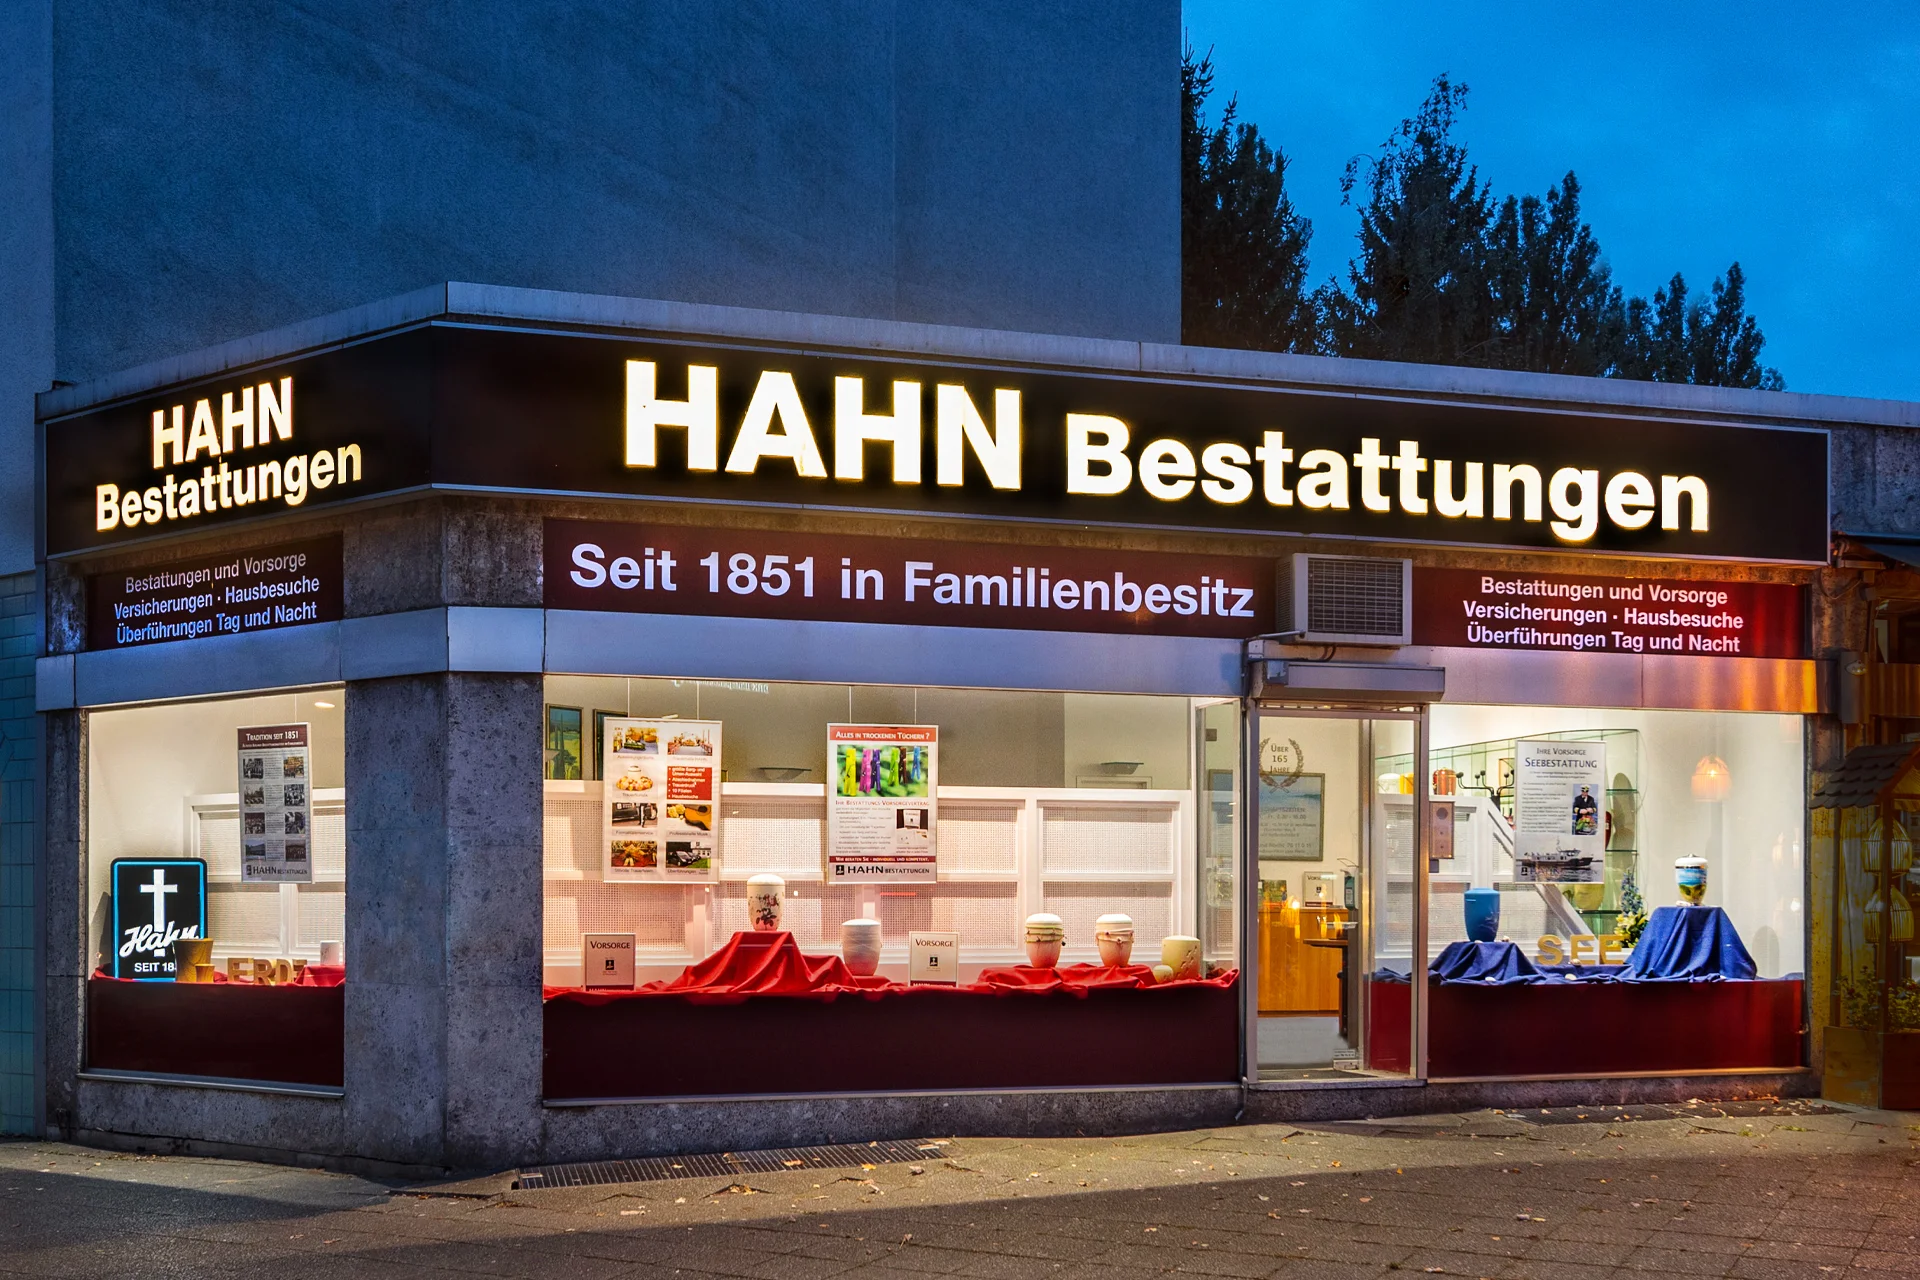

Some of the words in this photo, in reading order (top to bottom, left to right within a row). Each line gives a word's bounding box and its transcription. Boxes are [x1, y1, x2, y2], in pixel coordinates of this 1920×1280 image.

[152, 376, 293, 469] HAHN
[625, 359, 1022, 491] HAHN
[1065, 412, 1710, 542] Bestattungen
[96, 443, 362, 532] Bestattungen
[126, 568, 210, 594] Bestattungen
[214, 560, 240, 580] und
[244, 553, 307, 576] Vorsorge
[570, 543, 677, 591] Seit
[700, 551, 815, 598] 1851
[841, 557, 884, 601] in
[905, 560, 1255, 618] Familienbesitz
[114, 592, 213, 620] Versicherungen
[225, 575, 320, 604] Hausbesuche
[1481, 576, 1604, 601] Bestattungen
[1609, 584, 1643, 601] und
[1648, 584, 1728, 608] Vorsorge
[116, 617, 213, 644] Überführungen
[216, 613, 240, 633] Tag
[244, 607, 271, 627] und
[275, 601, 317, 624] Nacht
[1463, 600, 1607, 626] Versicherungen
[1624, 607, 1744, 629] Hausbesuche
[1467, 621, 1606, 650] Überführungen
[1611, 631, 1644, 652] Tag
[1649, 633, 1683, 650] und
[1688, 635, 1740, 652] Nacht
[284, 731, 299, 739] 1851
[1270, 743, 1289, 752] ÜBER
[1272, 755, 1288, 763] 165
[1524, 757, 1598, 768] SEEBESTATTUNG
[1536, 747, 1551, 755] IHRE
[1553, 747, 1587, 756] VORSORGE
[1270, 765, 1290, 773] JAHRE
[252, 866, 277, 875] HAHN
[847, 866, 884, 874] HAHN
[119, 920, 199, 958] Hahn
[590, 940, 631, 949] VORSORGE
[915, 938, 955, 947] VORSORGE
[1537, 934, 1625, 966] SEE
[134, 962, 160, 972] SEIT
[162, 962, 177, 972] 18
